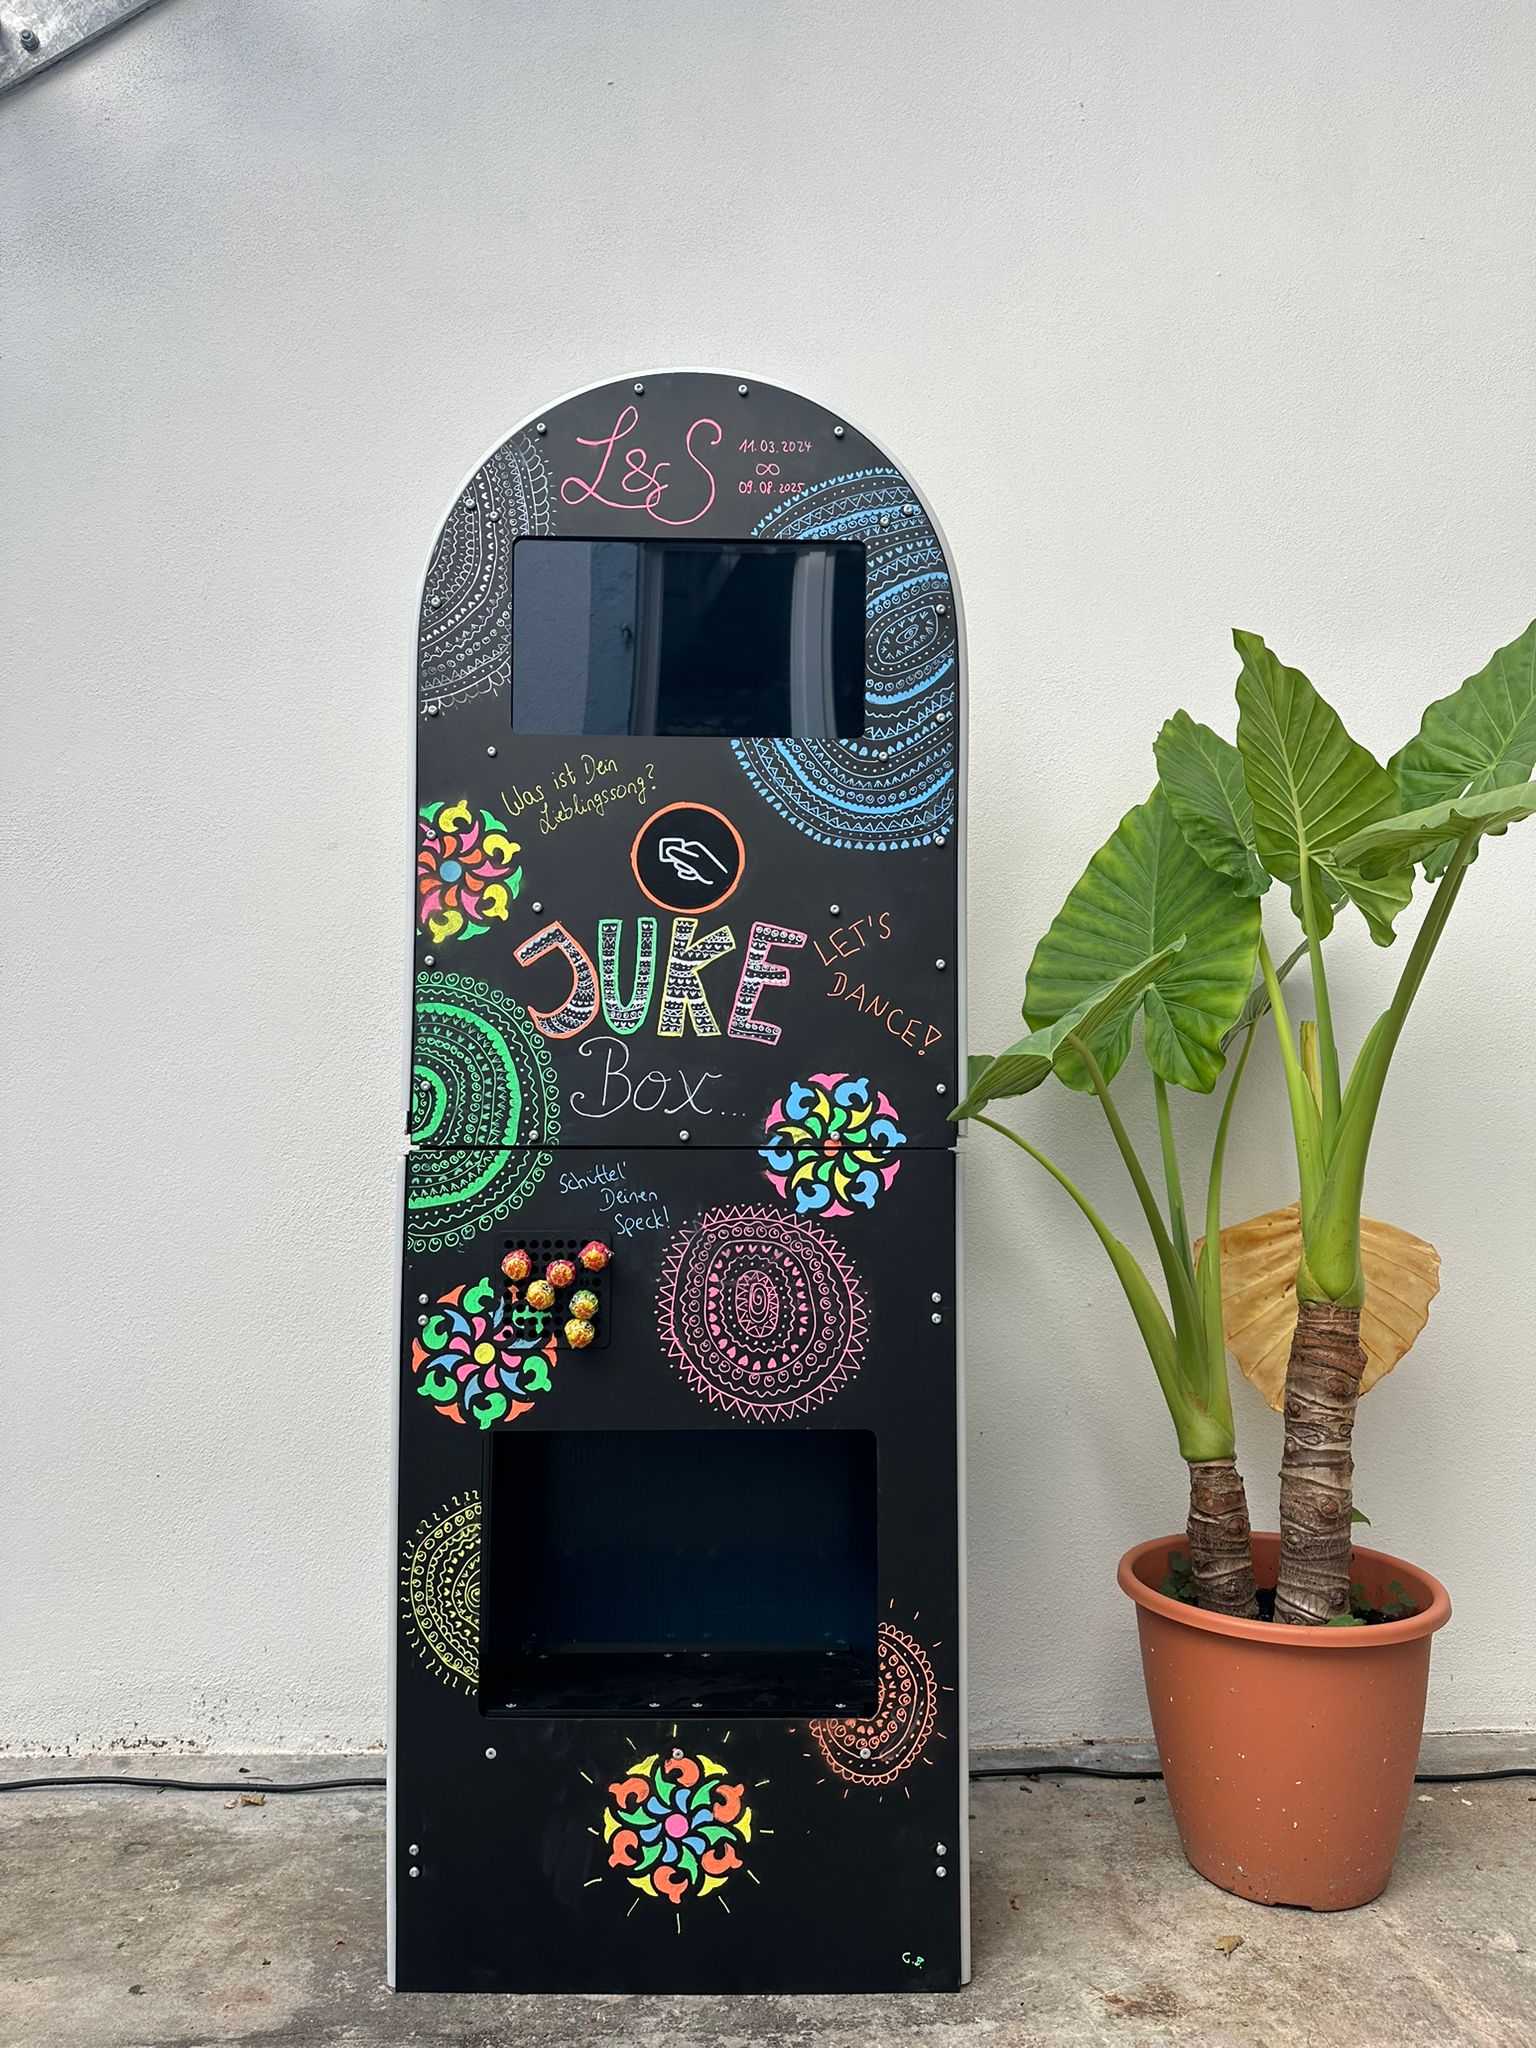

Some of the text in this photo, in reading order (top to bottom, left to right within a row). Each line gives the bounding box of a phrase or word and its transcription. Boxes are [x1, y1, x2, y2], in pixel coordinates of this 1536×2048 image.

[738, 438, 813, 454] 11.03.2024
[738, 481, 806, 495] 09.08.2025
[501, 754, 618, 816] Was ist Dein
[539, 763, 656, 835] Lieblingssong?
[813, 911, 891, 966] LET'S
[513, 916, 808, 1046] JUKE
[826, 971, 942, 1056] DANCE!
[599, 1187, 658, 1212] Deinen
[614, 1205, 671, 1237] Speck!
